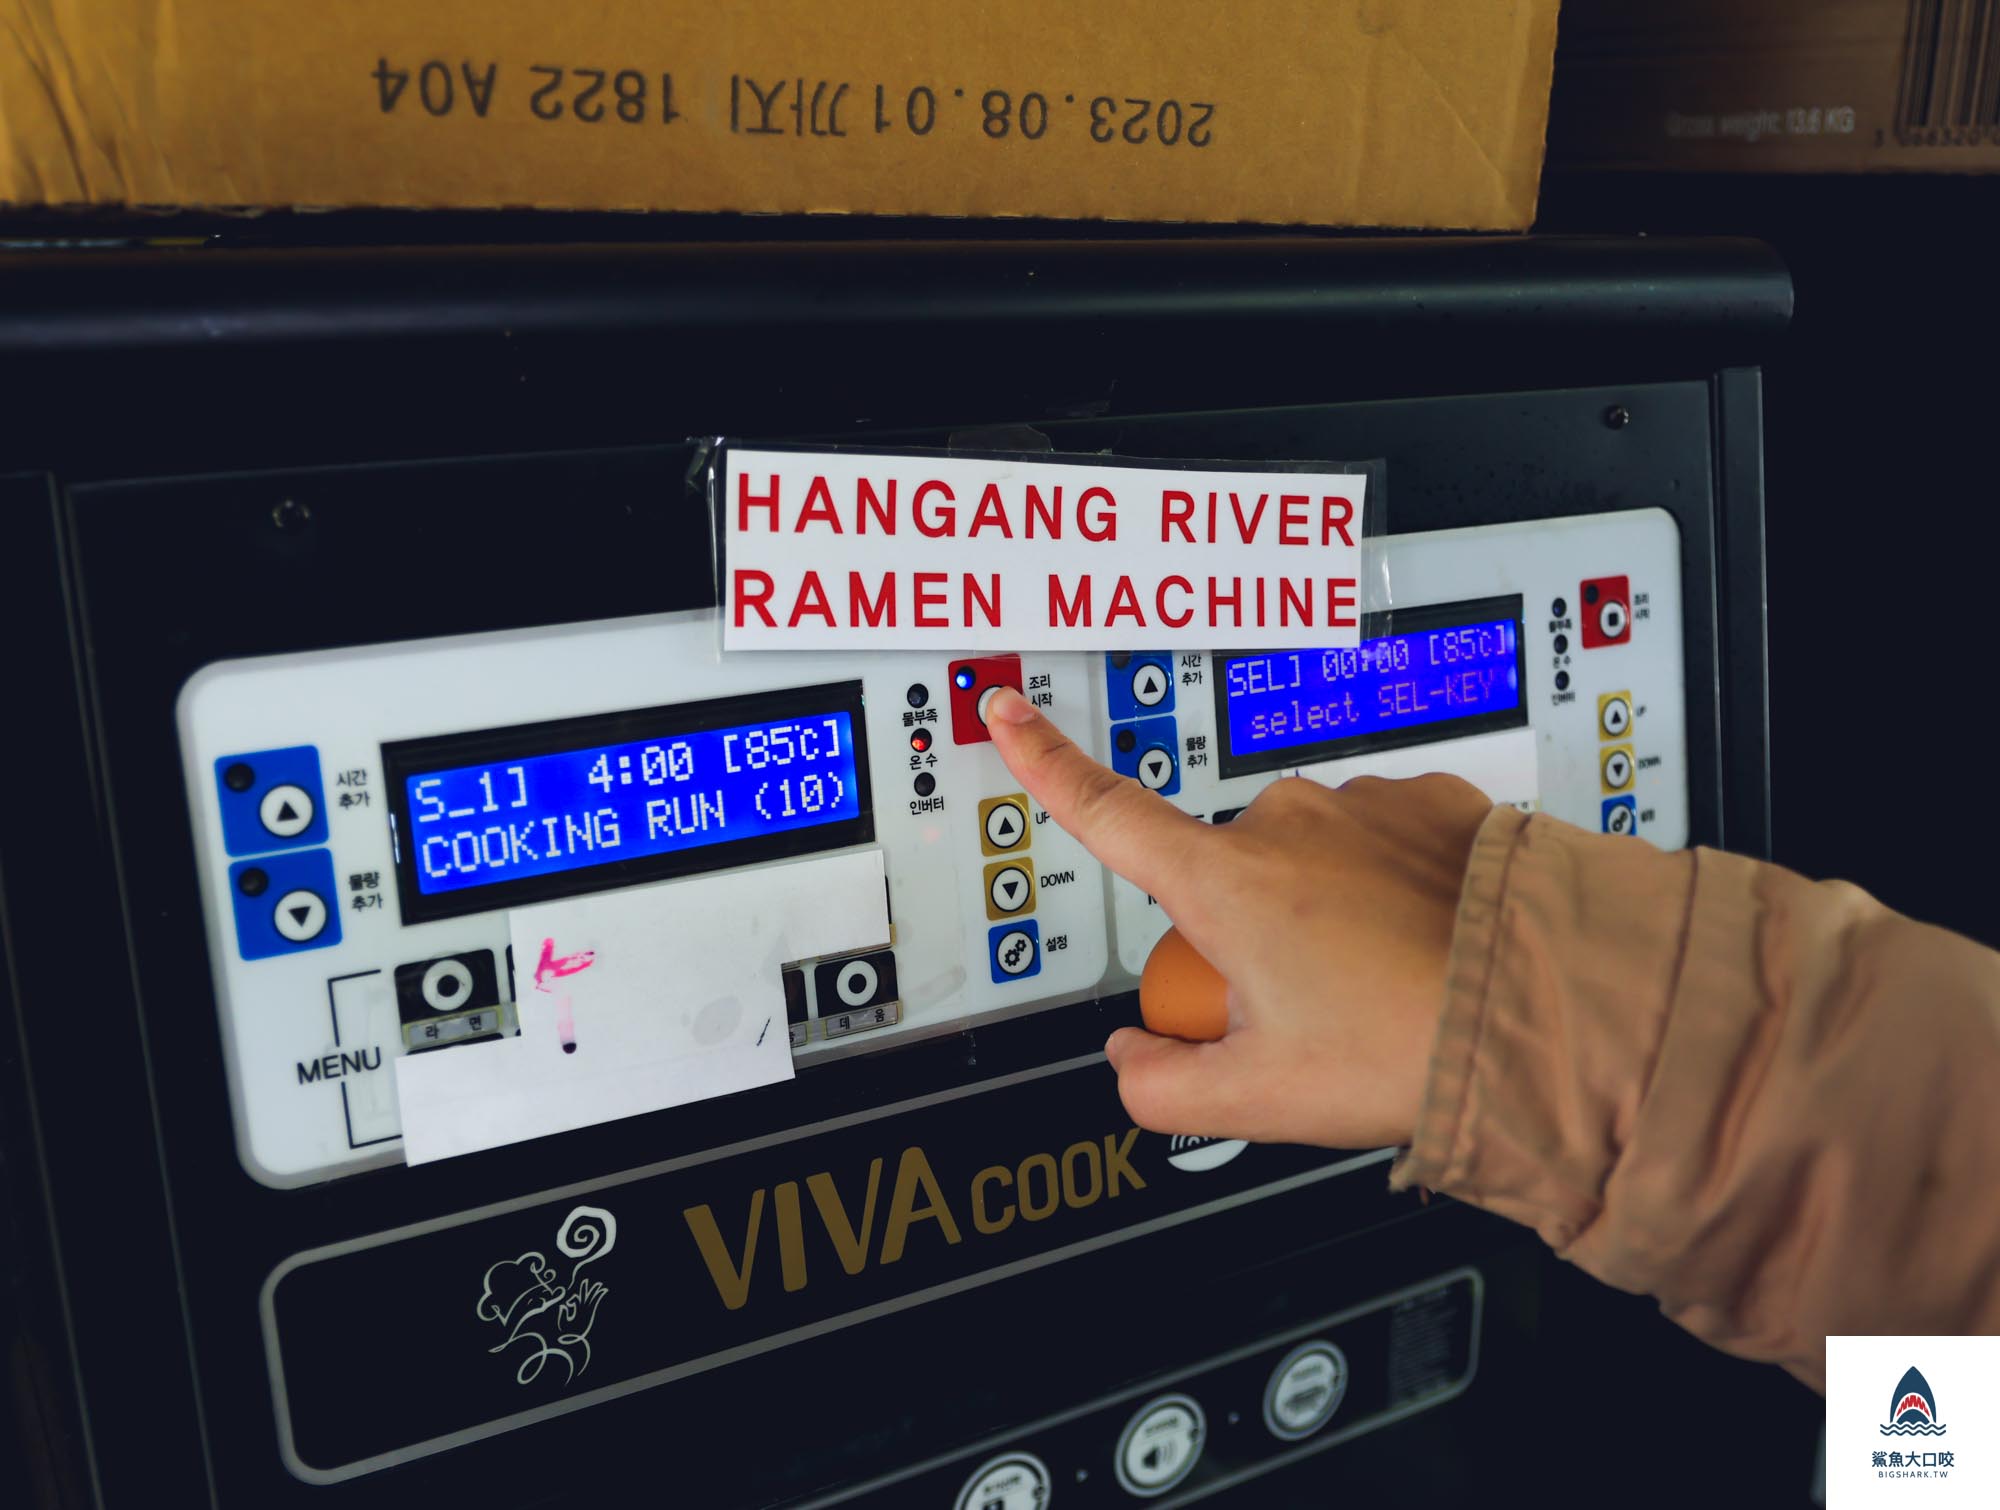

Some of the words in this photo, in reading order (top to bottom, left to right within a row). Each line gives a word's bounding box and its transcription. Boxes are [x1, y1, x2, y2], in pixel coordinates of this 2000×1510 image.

[373, 57, 496, 118] A04
[530, 64, 679, 125] 1822
[738, 473, 1117, 542] HANGANG
[1161, 490, 1354, 546] RIVER
[733, 569, 1001, 628] RAMEN
[1048, 574, 1356, 628] MACHINE
[1181, 653, 1202, 668] 시간
[1322, 640, 1410, 682] 00:00
[1029, 673, 1051, 690] 조리
[1182, 671, 1203, 686] 추가
[1031, 692, 1053, 708] 시작
[1251, 698, 1361, 739] select
[1379, 669, 1495, 718] SEL-KEY
[902, 709, 938, 727] 물부족
[588, 742, 694, 792] 4:00
[1187, 753, 1208, 768] 추가
[336, 769, 367, 787] 시간
[339, 790, 370, 810] 추가
[909, 796, 944, 815] 인버터
[423, 808, 620, 877] COOKING
[647, 790, 725, 839] RUN
[755, 772, 844, 819] (10)
[1040, 870, 1074, 888] DOWN
[352, 892, 384, 912] 추가
[1046, 934, 1068, 952] 설정
[296, 1047, 382, 1085] MENU
[683, 1146, 963, 1311] VIVA
[970, 1127, 1147, 1234] COOK
